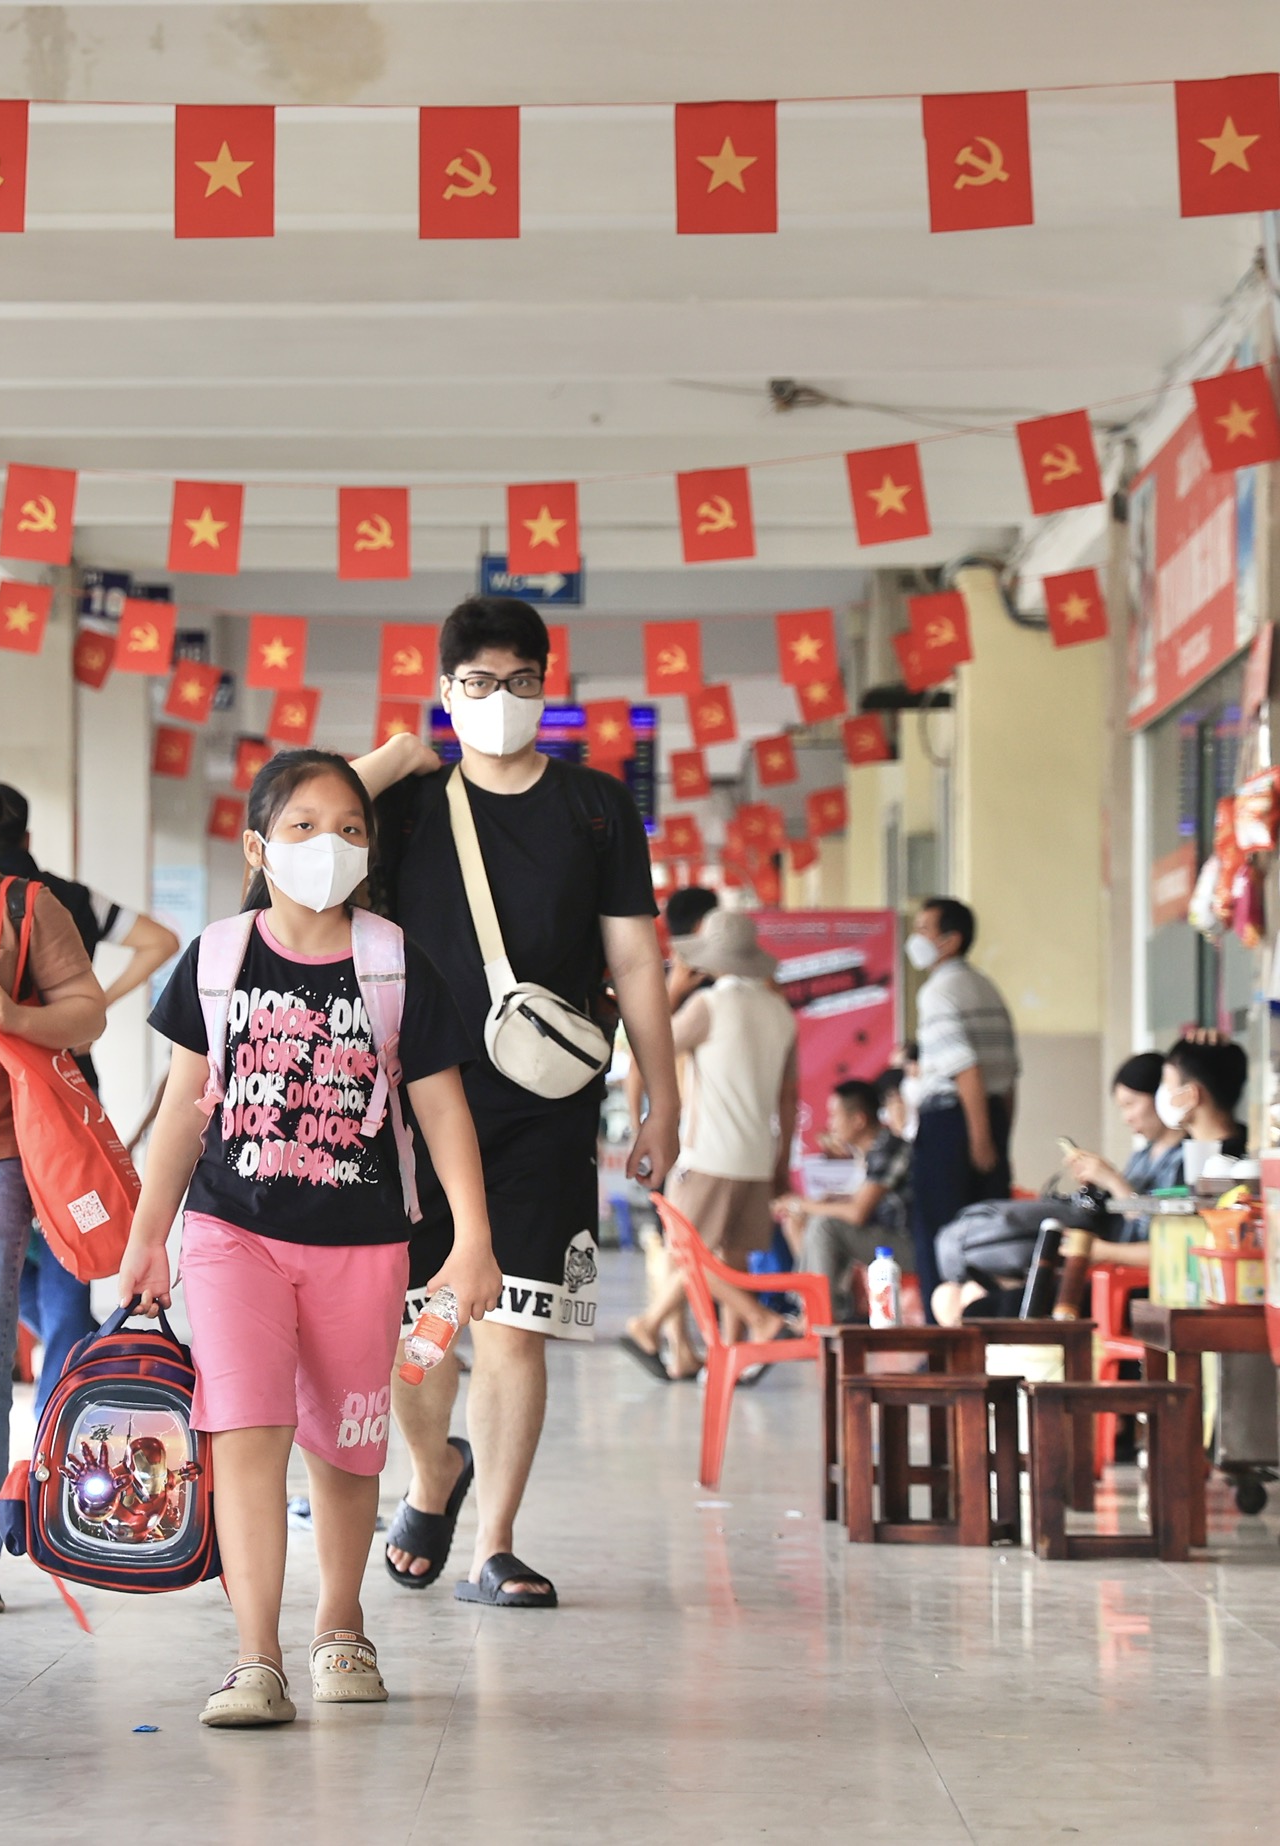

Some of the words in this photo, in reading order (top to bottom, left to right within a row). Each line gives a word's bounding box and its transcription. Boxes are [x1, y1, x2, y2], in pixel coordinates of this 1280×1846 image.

[250, 1006, 332, 1042] DIOR
[236, 1040, 304, 1078] DIOR
[313, 1044, 377, 1084] DIOR
[286, 1080, 343, 1114] DIOR
[221, 1103, 286, 1142] DIOR
[297, 1111, 364, 1149] DIOR
[256, 1142, 340, 1188] DIOR
[336, 1409, 390, 1450] DIO
